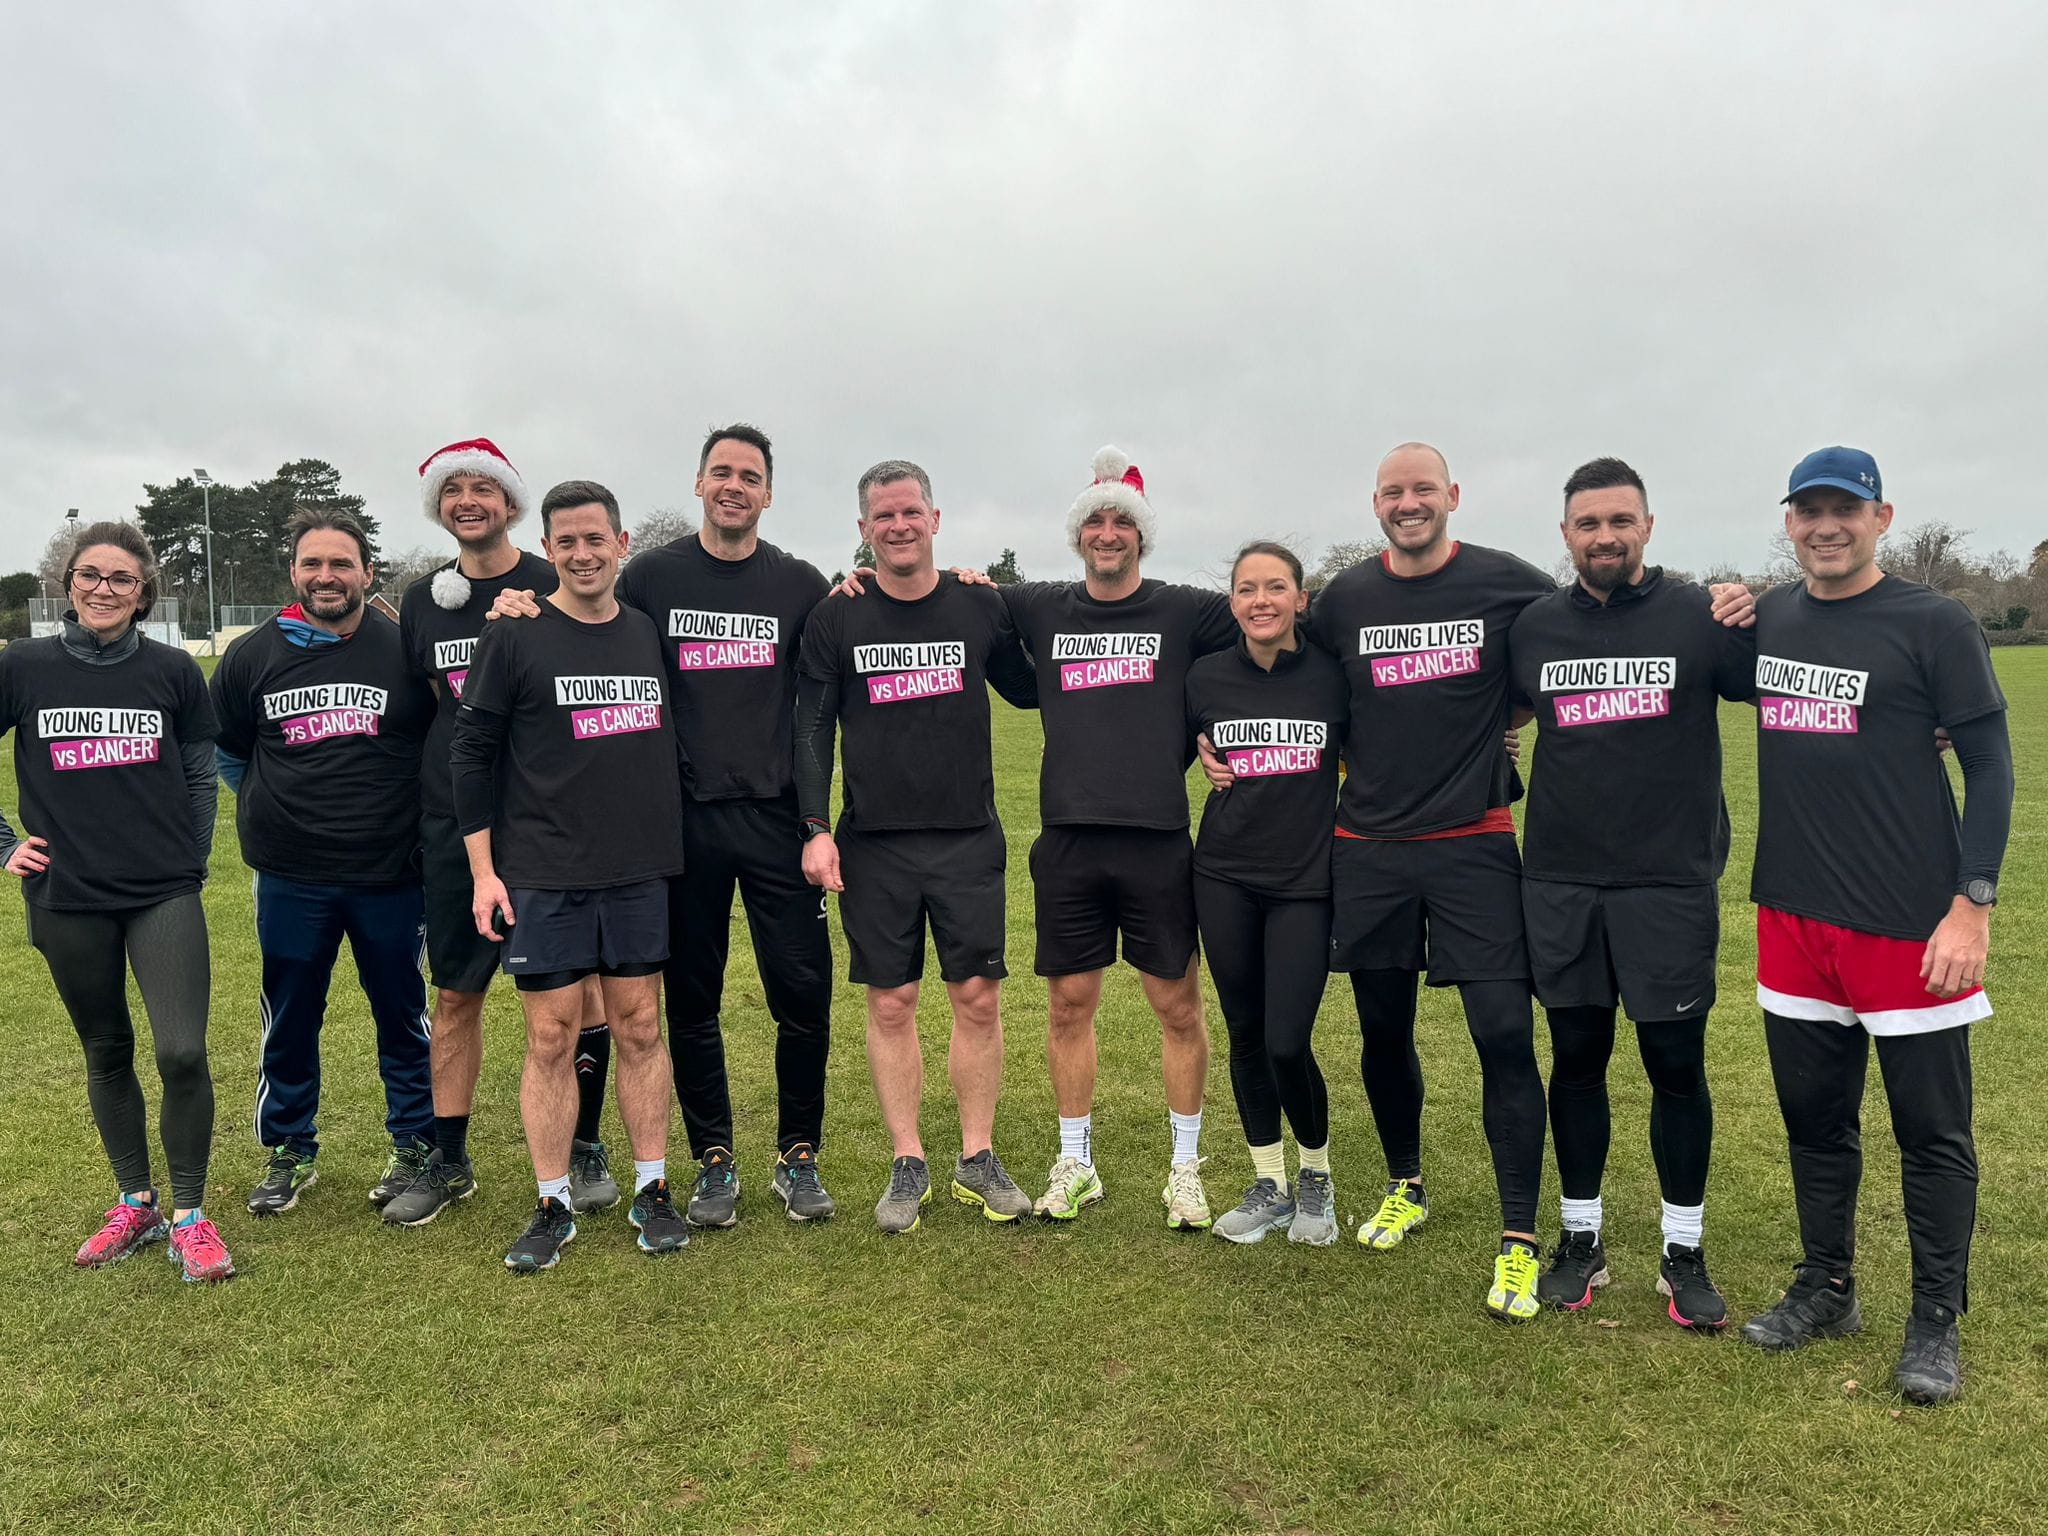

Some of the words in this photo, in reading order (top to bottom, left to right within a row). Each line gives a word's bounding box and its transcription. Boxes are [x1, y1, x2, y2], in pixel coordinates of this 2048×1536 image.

[674, 612, 726, 637] YOUNG
[730, 616, 774, 640] LIVES
[1364, 627, 1421, 651] YOUNG
[1427, 623, 1479, 647] LIVES
[683, 650, 702, 667] vs
[706, 642, 771, 666] CANCER
[859, 646, 912, 670] YOUNG
[918, 645, 961, 667] LIVES
[1058, 636, 1107, 656] YOUNG
[1111, 636, 1157, 657] LIVES
[1065, 670, 1083, 687] vs
[1087, 658, 1150, 684] CANCER
[1375, 665, 1398, 683] vs
[1401, 647, 1476, 680] CANCER
[1546, 662, 1607, 687] YOUNG
[1613, 661, 1670, 685] LIVES
[560, 679, 617, 702] YOUNG
[621, 679, 659, 702] LIVES
[872, 683, 892, 700] vs
[895, 668, 960, 697] CANCER
[1757, 659, 1806, 692] YOUNG
[1808, 669, 1860, 701] LIVES
[269, 687, 329, 716] YOUNG
[334, 686, 383, 711] LIVES
[1559, 703, 1582, 723] vs
[1585, 688, 1665, 720] CANCER
[1762, 706, 1777, 725] vs
[1780, 700, 1853, 730] CANCER
[43, 711, 103, 735] YOUNG
[109, 711, 159, 735] LIVES
[284, 725, 306, 741] vs
[308, 710, 374, 737] CANCER
[577, 717, 599, 735] vs
[601, 704, 657, 732] CANCER
[1218, 722, 1271, 744] YOUNG
[1277, 722, 1324, 745] LIVES
[54, 749, 77, 767] vs
[80, 738, 154, 765] CANCER
[1231, 758, 1249, 774] vs
[1252, 747, 1317, 773] CANCER
